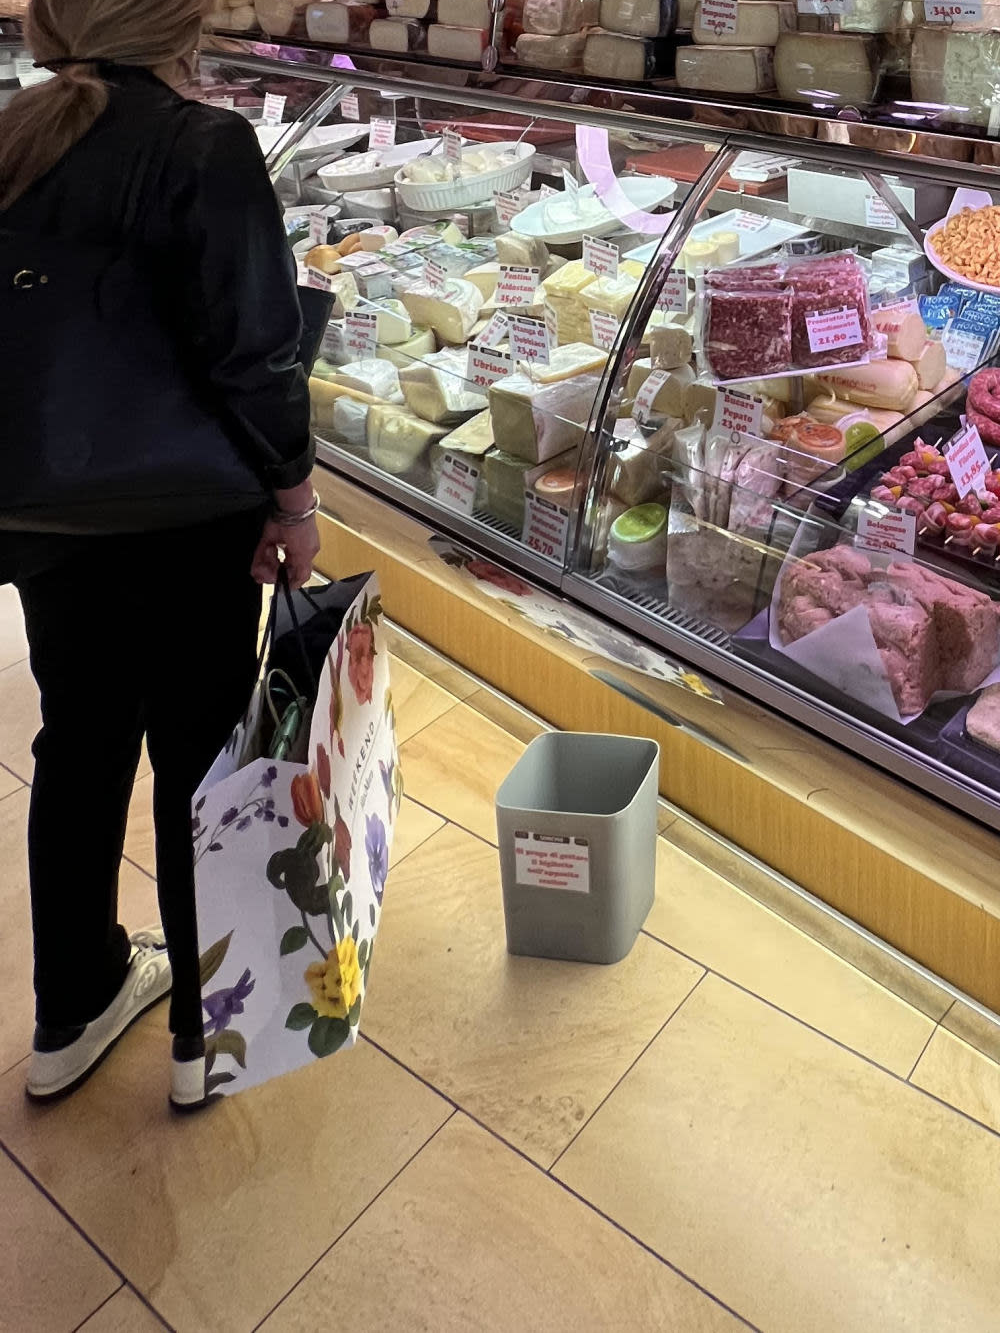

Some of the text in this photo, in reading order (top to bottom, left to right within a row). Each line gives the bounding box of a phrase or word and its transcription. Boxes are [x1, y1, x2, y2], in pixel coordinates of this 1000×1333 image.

[933, 6, 961, 16] 34,10
[818, 333, 847, 345] 21,80
[473, 358, 508, 374] Ubriaco
[721, 419, 747, 432] 23,00
